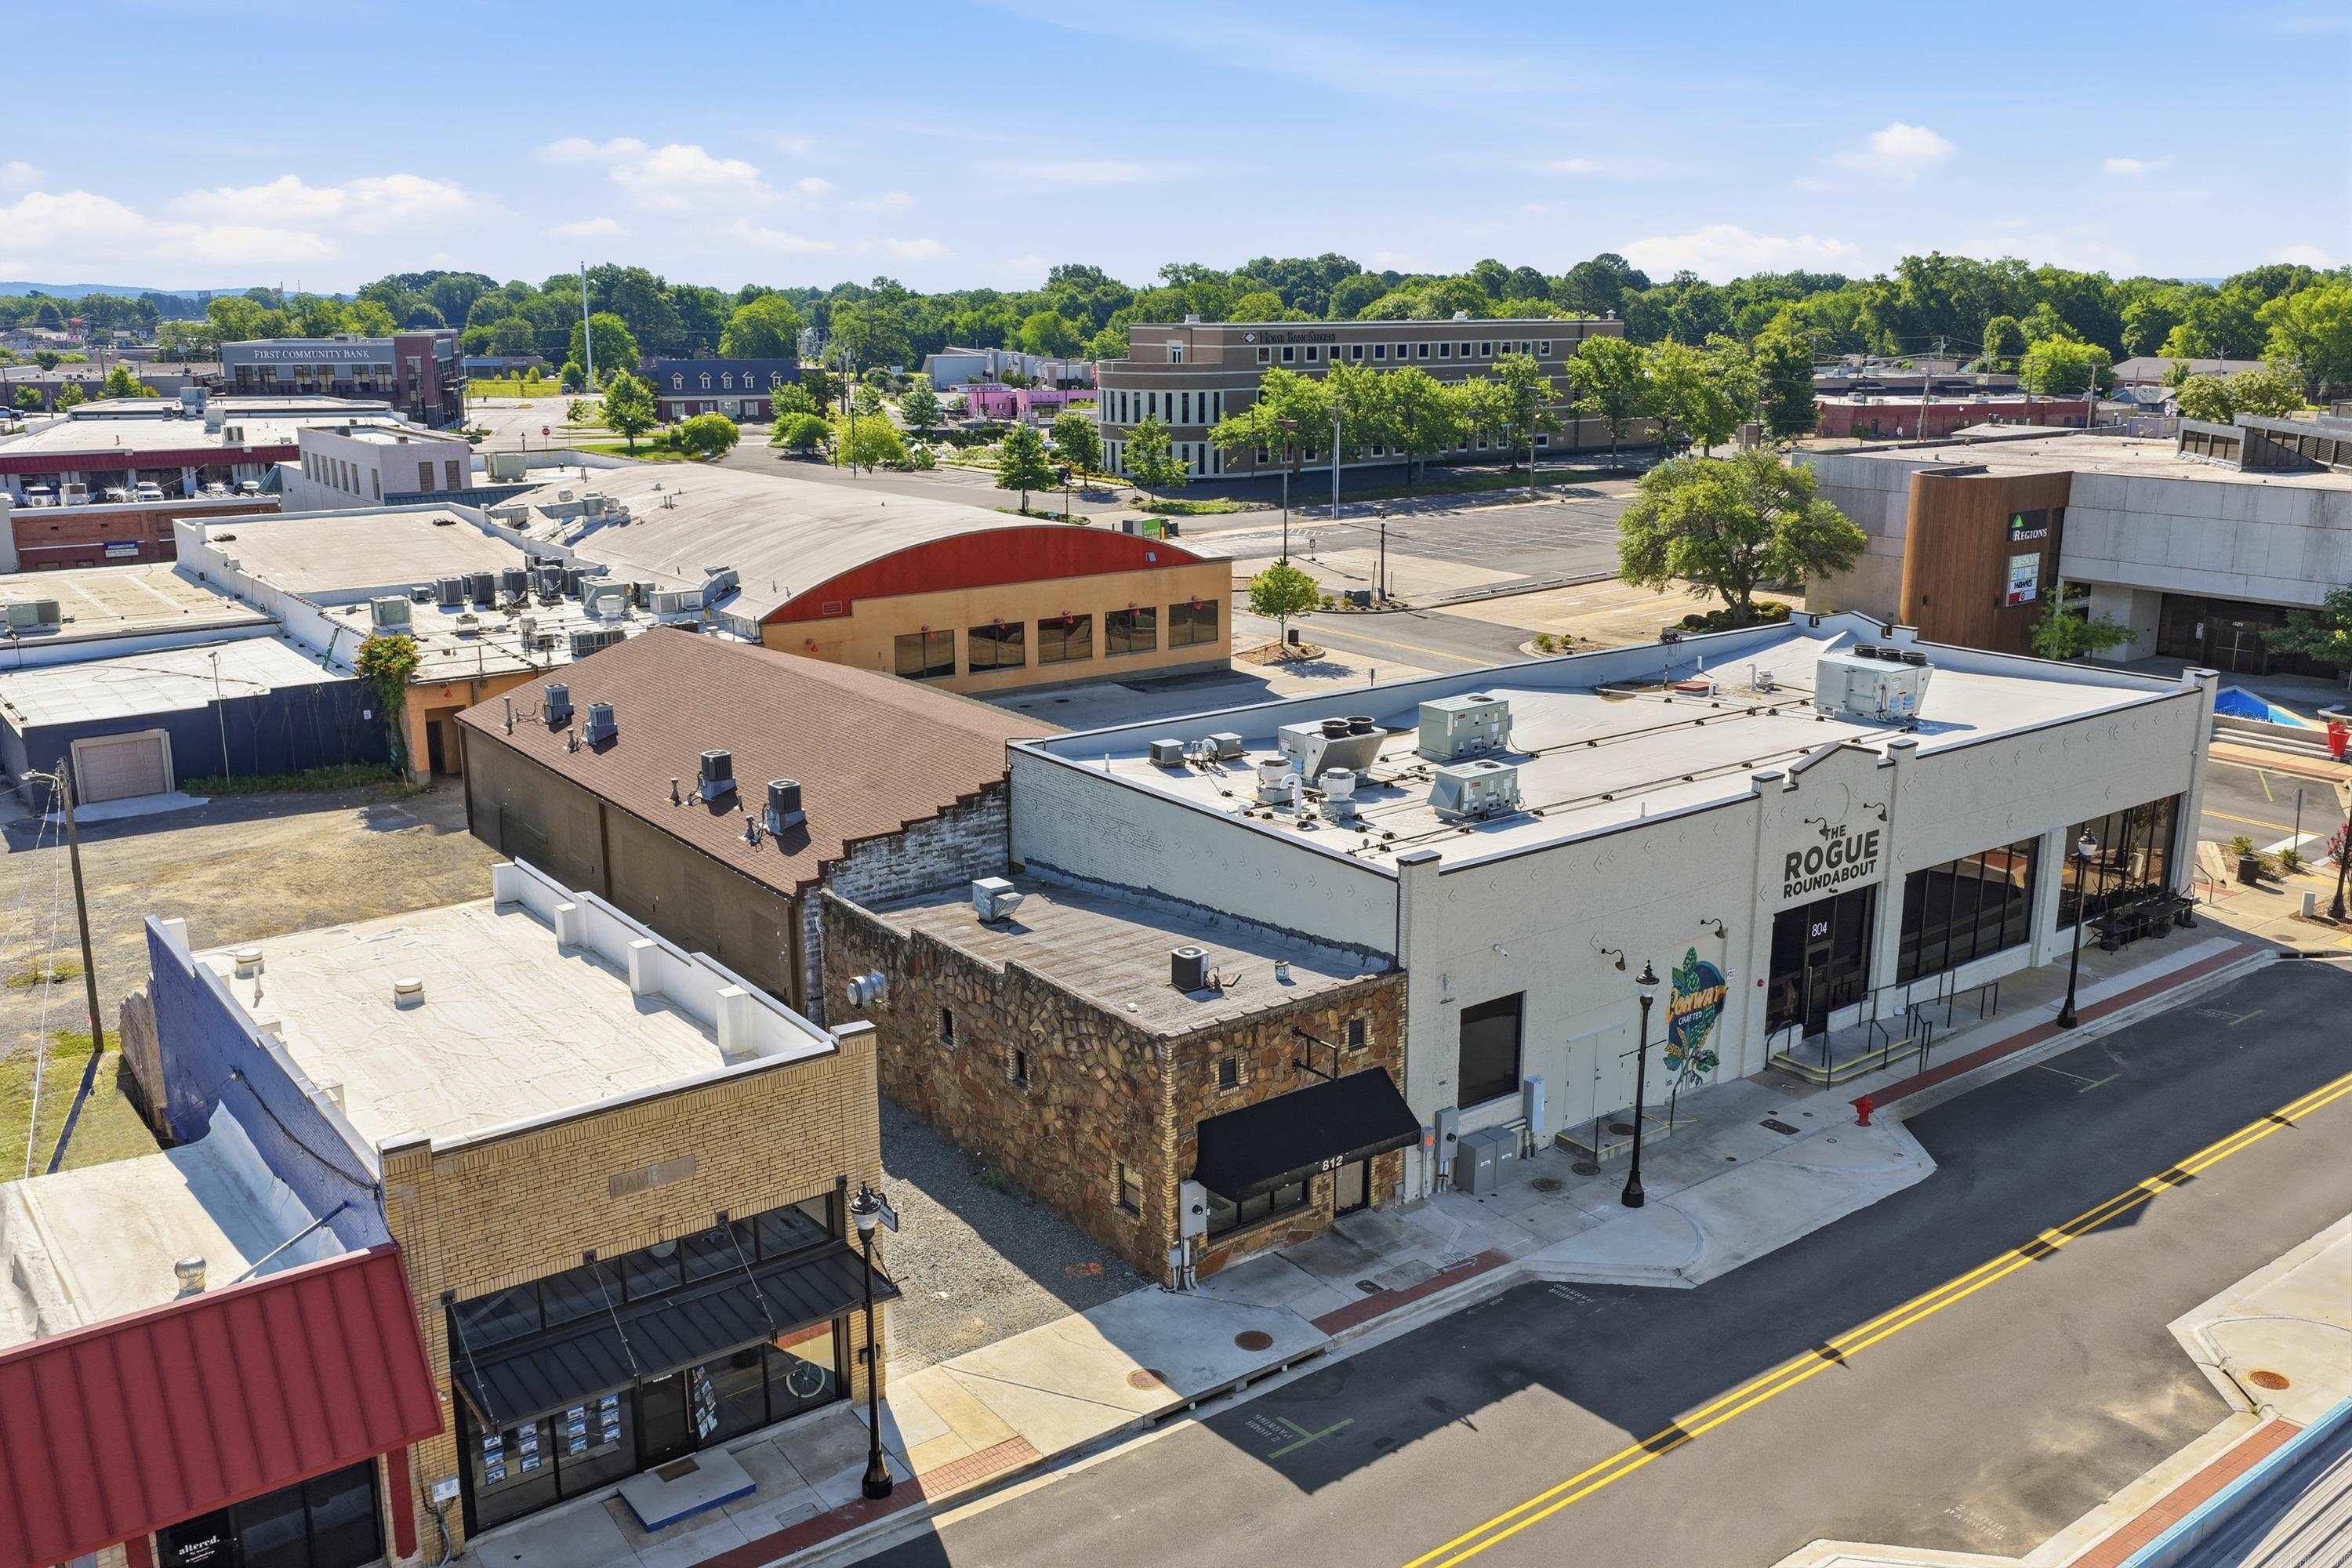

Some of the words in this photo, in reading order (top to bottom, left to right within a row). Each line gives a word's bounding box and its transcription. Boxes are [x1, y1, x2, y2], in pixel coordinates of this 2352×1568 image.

[254, 350, 280, 358] FIRST
[282, 350, 342, 359] COMMUNITY
[343, 350, 370, 358] BANK
[2013, 528, 2048, 541] REGIONS
[1824, 824, 1847, 841] THE
[1784, 829, 1880, 882] ROGUE
[1783, 859, 1877, 899] ROUNDABOUT
[1812, 921, 1828, 937] 804
[1678, 1011, 1703, 1025] CRAFTED
[1322, 1155, 1343, 1171] 812
